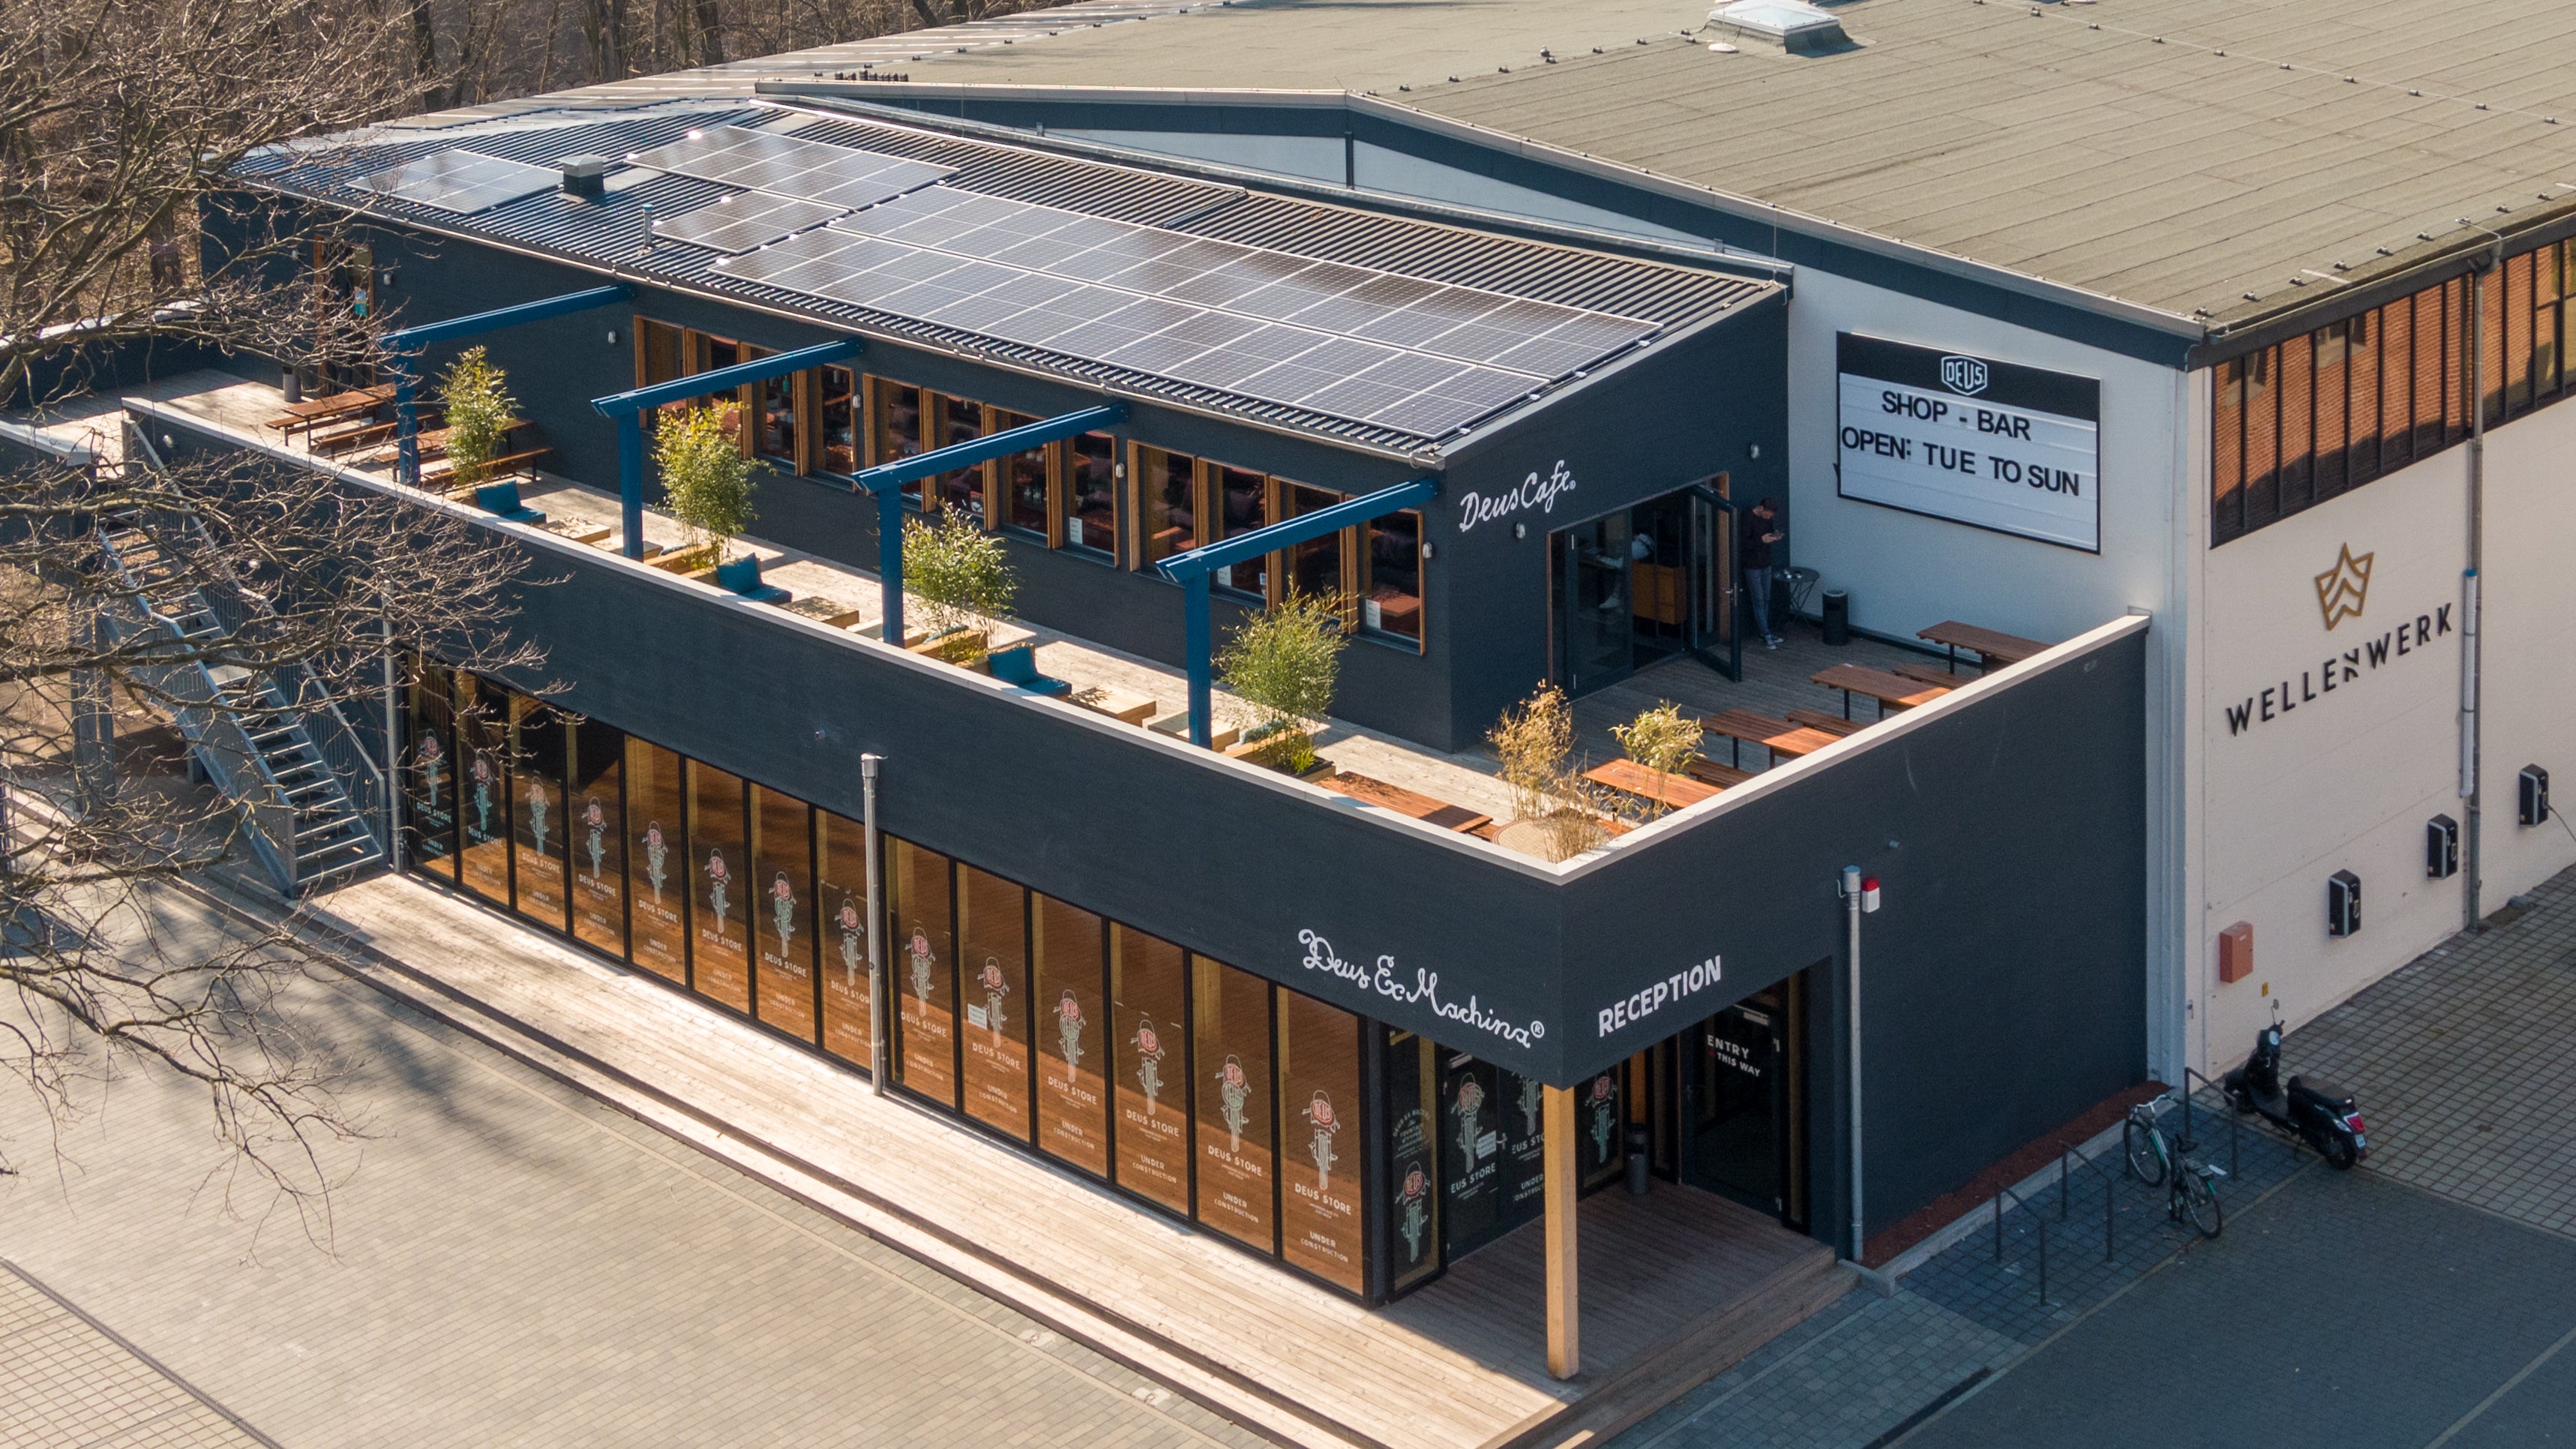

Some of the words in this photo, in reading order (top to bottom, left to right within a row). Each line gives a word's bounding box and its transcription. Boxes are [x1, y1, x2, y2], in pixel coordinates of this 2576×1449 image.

[1945, 361, 1983, 389] DEUS
[1882, 391, 1948, 423] SHOP
[1978, 409, 2032, 441] BAR
[1842, 427, 1912, 460] OPEN:
[1923, 442, 1976, 474] TUE
[1989, 455, 2022, 484] TO
[2028, 465, 2080, 496] SUN
[2226, 602, 2452, 736] WELLENWERK
[417, 802, 431, 815] DEUS
[484, 833, 502, 848] STORE
[522, 852, 538, 866] DEUS
[539, 860, 560, 874] STORE
[579, 874, 595, 887] DEUS
[596, 882, 616, 897] STORE
[638, 900, 655, 914] DEUS
[657, 908, 678, 923] STORE
[649, 938, 667, 951] UNDER
[702, 928, 718, 943] DEUS
[721, 936, 742, 952] STORE
[764, 952, 782, 966] DEUS
[784, 961, 807, 977] STORE
[1299, 929, 1372, 989] Deus
[775, 993, 796, 1006] UNDER
[831, 980, 848, 996] DEUS
[850, 990, 870, 1004] STOR
[1599, 955, 1722, 1038] RECEPTION
[841, 1022, 862, 1036] UNDER
[901, 1011, 920, 1026] DEUS
[922, 1020, 947, 1037] STORE
[973, 1042, 994, 1058] DEUS
[997, 1052, 1021, 1070] STORE
[1708, 1034, 1749, 1059] ENTRY
[914, 1053, 934, 1067] UNDER
[1717, 1052, 1737, 1066] THIS
[1740, 1061, 1761, 1077] WAY
[987, 1084, 1008, 1100] UNDER
[1048, 1076, 1069, 1092] DEUS
[1072, 1087, 1097, 1106] STORE
[1061, 1120, 1084, 1136] UNDER
[1126, 1109, 1148, 1125] DEUS
[1151, 1120, 1180, 1137] STORE
[1054, 1127, 1095, 1150] CONSTRUCTION
[1511, 1140, 1528, 1154] EUS
[1132, 1162, 1177, 1184] CONSTRUCTION
[1141, 1154, 1165, 1170] UNDER
[1208, 1145, 1231, 1162] DEUS
[1235, 1156, 1262, 1177] STORE
[1450, 1178, 1467, 1193] EUS
[1470, 1162, 1496, 1184] STORE
[1521, 1174, 1543, 1190] UNDER
[1214, 1199, 1258, 1223] CONSTRUCTION
[1223, 1192, 1247, 1208] UNDER
[1295, 1183, 1319, 1201] DEUS
[1323, 1194, 1351, 1216] STORE
[1300, 1238, 1348, 1263] CONSTRUCTION
[1309, 1231, 1336, 1248] UNDER
